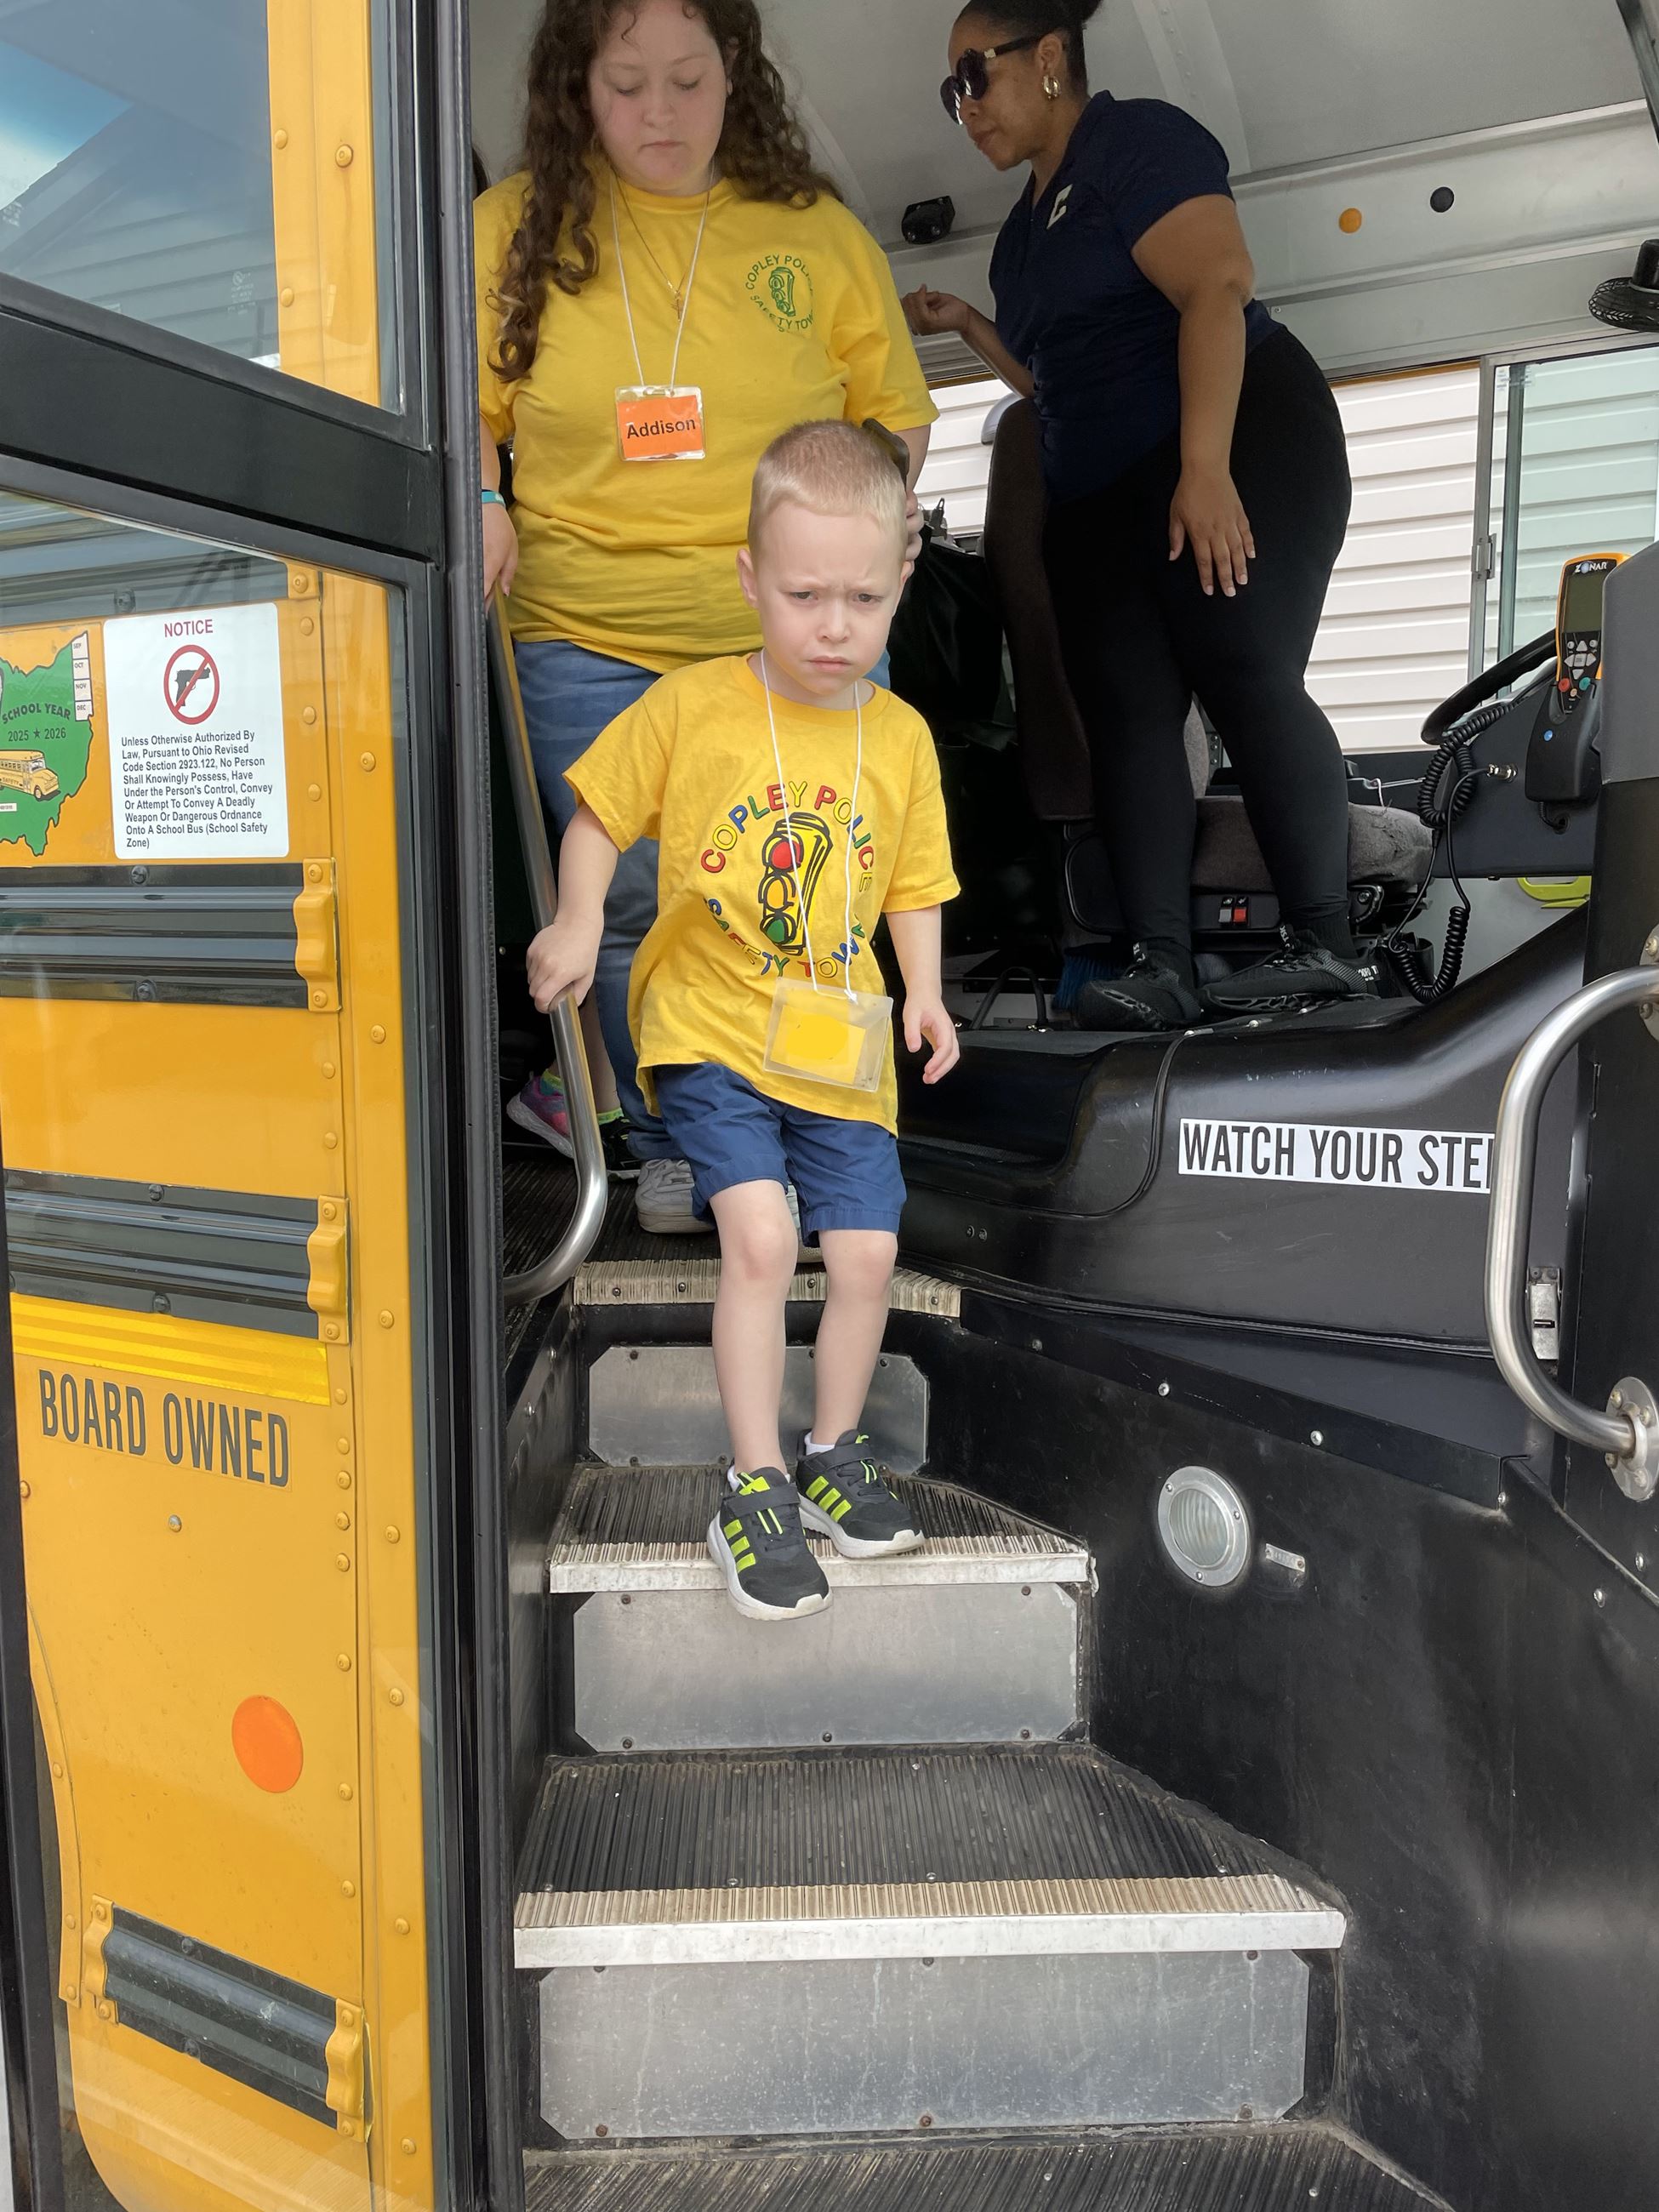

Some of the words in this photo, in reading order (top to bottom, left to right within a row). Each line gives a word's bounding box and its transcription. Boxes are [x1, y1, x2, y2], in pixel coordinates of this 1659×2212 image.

[745, 254, 779, 290] COPLEY
[626, 418, 696, 439] Addison
[164, 619, 213, 637] NOTICE
[2, 703, 42, 725] SCHOOL
[44, 703, 71, 720] YEAR
[8, 730, 29, 742] 2025
[44, 727, 66, 739] 2026
[121, 737, 149, 746] Unless
[151, 733, 192, 745] Otherwise
[195, 731, 241, 743] Authorized
[243, 730, 254, 742] By
[122, 750, 140, 760] Law,
[142, 748, 180, 758] Pursuant
[181, 747, 190, 756] to
[192, 746, 212, 755] Ohio
[214, 744, 249, 754] Revised
[123, 762, 144, 772] Code
[145, 761, 177, 771] Section
[179, 759, 218, 769] 2923.122,
[220, 758, 232, 767] No
[234, 757, 265, 767] Person
[123, 774, 144, 784] Shall
[145, 772, 189, 784] Knowingly
[191, 772, 230, 782] Possess,
[231, 771, 253, 780] Have
[124, 788, 148, 797] Under
[151, 787, 163, 796] the
[166, 785, 202, 795] Person's
[204, 784, 238, 795] Control,
[240, 783, 273, 795] Convey
[124, 800, 134, 810] Or
[136, 800, 169, 811] Attempt
[171, 799, 181, 808] To
[183, 798, 214, 809] Convey
[217, 797, 224, 807] A
[225, 796, 255, 808] Deadly
[125, 812, 158, 824] Weapon
[160, 812, 170, 821] Or
[173, 811, 218, 823] Dangerous
[220, 810, 262, 820] Ordnance
[126, 825, 145, 835] Onto
[147, 824, 154, 834] A
[156, 824, 185, 834] School
[187, 824, 203, 833] Bus
[206, 823, 238, 835] (School
[241, 822, 268, 835] Safety
[700, 780, 807, 873] COPLEY
[813, 784, 874, 892] POLICE
[127, 838, 150, 849] Zone)
[1183, 1122, 1296, 1176] WATCH
[1309, 1129, 1403, 1183] YOUR
[1417, 1134, 1495, 1189] STE
[39, 1368, 146, 1457] BOARD
[162, 1392, 289, 1488] OWNED
